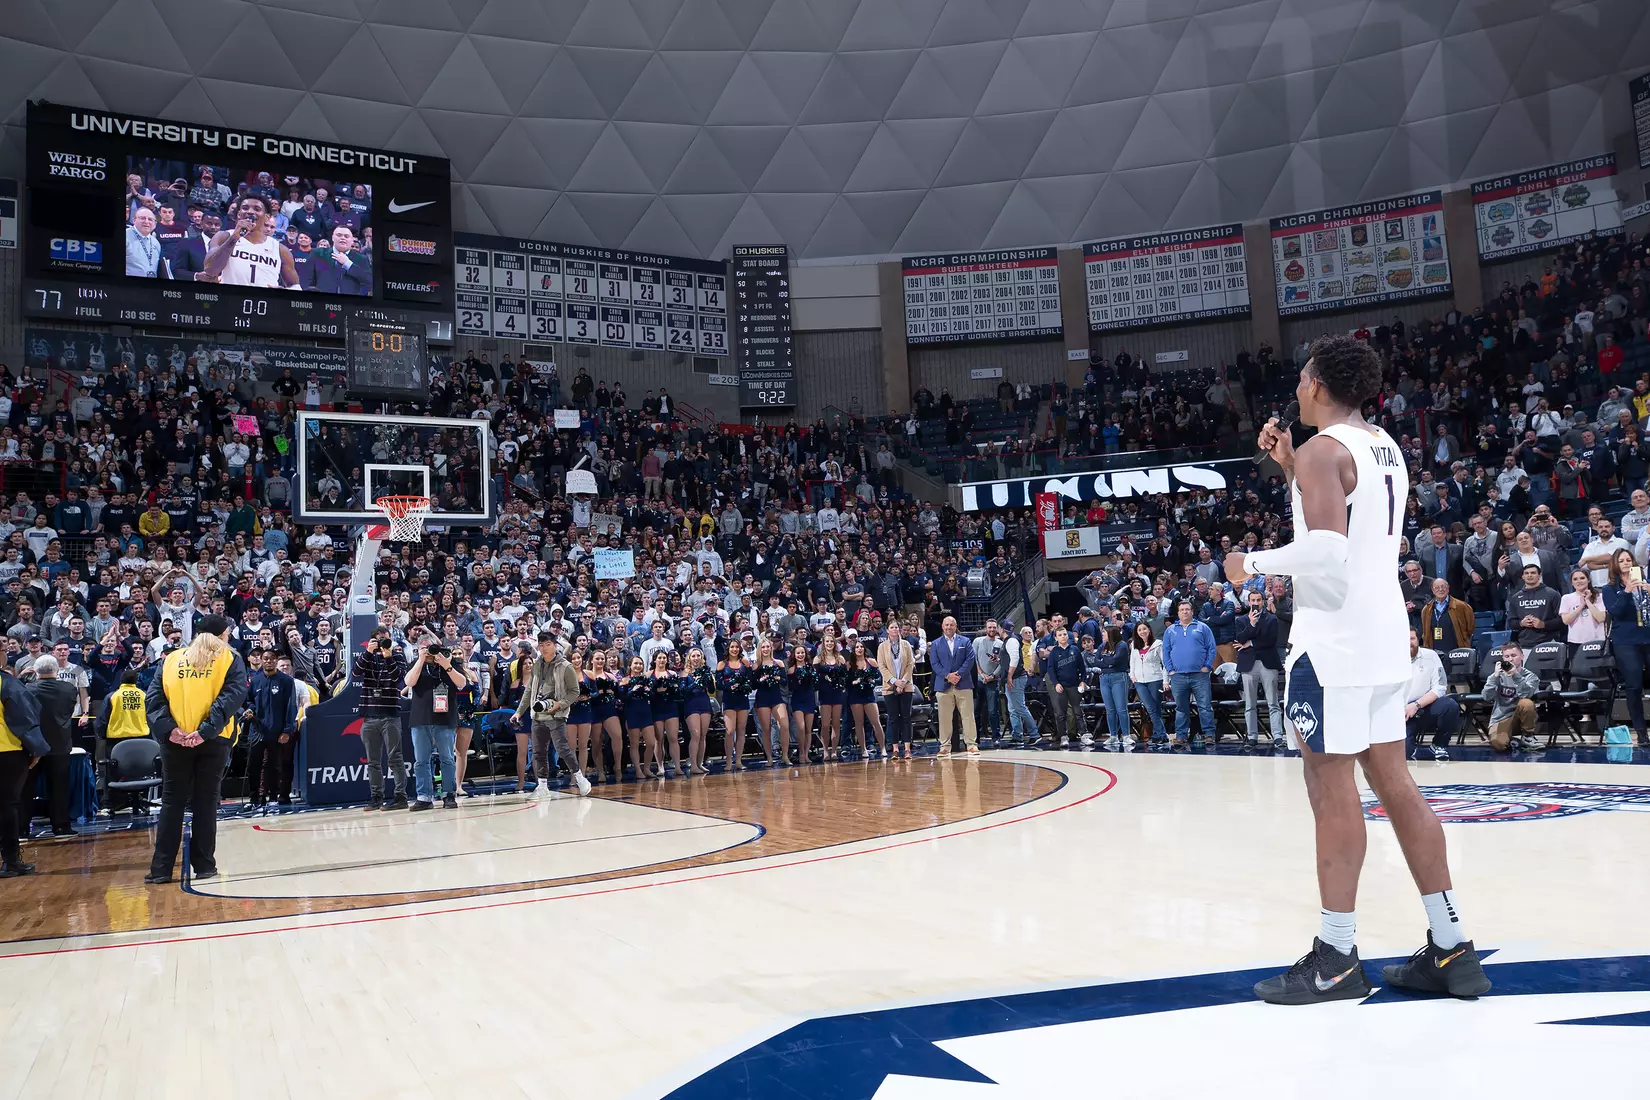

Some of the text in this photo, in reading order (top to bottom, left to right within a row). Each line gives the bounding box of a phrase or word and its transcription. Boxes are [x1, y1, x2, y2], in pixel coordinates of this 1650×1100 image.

[71, 113, 417, 174] UNIVERSITY OF CONNECTICUT
[48, 151, 106, 168] WELLS
[50, 165, 105, 180] FARGO
[1475, 178, 1512, 192] NCAA
[1517, 173, 1587, 193] FINAL FOUR
[1280, 195, 1431, 227] NCAA CHAMPIONSHIP
[1324, 214, 1387, 228] FINAL FOUR
[50, 238, 97, 254] CBS
[402, 239, 436, 248] DUNKIN'
[1093, 228, 1233, 253] NCAA CHAMPIONSHIP
[1483, 236, 1582, 260] CONNECTICUT WOMEN'S
[401, 246, 436, 255] DONUTS
[519, 242, 557, 252] UCONN
[564, 247, 611, 258] HUSKIES
[635, 256, 670, 265] HONOR
[1132, 243, 1193, 256] ELITE EIGHT
[230, 250, 277, 267] UCONN
[912, 250, 1048, 266] NCAA CHAMPIONSHIP
[1089, 246, 1242, 274] 1991 1994 1995 1996 1997 1998 2000
[76, 263, 102, 271] Company
[250, 265, 256, 283] 1
[941, 262, 1019, 273] SWEET SIXTEEN
[466, 267, 479, 283] 32
[507, 271, 513, 286] 3
[908, 268, 1055, 288] 1991 1994 1995 1996 1997 1998 1999
[386, 282, 430, 292] TRAVELERS
[574, 278, 587, 293] 20
[609, 281, 620, 297] 31
[641, 284, 653, 300] 23
[35, 289, 61, 309] 77
[163, 290, 181, 299] POSS
[195, 293, 218, 302] BONUS
[673, 288, 686, 303] 31
[705, 291, 718, 306] 14
[1279, 286, 1449, 316] CONNECTICUT WOMEN'S BASKETBALL
[80, 307, 101, 317] FULL
[291, 301, 312, 309] BONUS
[1092, 310, 1108, 320] 2016
[1115, 307, 1130, 317] 2017
[1160, 301, 1176, 312] 2019
[125, 311, 156, 321] 30 SEC
[180, 315, 210, 324] TM FLS
[462, 311, 483, 328] 23
[505, 315, 515, 331] 4
[1092, 306, 1249, 331] CONNECTICUT WOMEN'S BASKETBALL
[299, 323, 310, 332] TM
[313, 325, 326, 333] FLS
[537, 318, 556, 334] 30
[577, 321, 587, 336] 3
[606, 323, 625, 340] CD
[909, 316, 1035, 333] 2014 2015 2016 2017 2018 2019
[642, 327, 655, 342] 15
[671, 329, 692, 345] 24
[704, 333, 723, 347] 33
[909, 328, 1061, 344] CONNECTICUT WOMEN'S BASKETBALL
[264, 350, 285, 359] Harry
[300, 352, 331, 362] Gampel
[275, 360, 318, 370] Basketball
[993, 369, 997, 377] 1
[721, 377, 738, 385] 205
[759, 391, 785, 403] 9:22
[1372, 446, 1398, 467] VITAL
[1385, 475, 1395, 536] 1
[965, 540, 983, 549] 105
[318, 655, 329, 663] 50
[178, 670, 212, 678] STAFF
